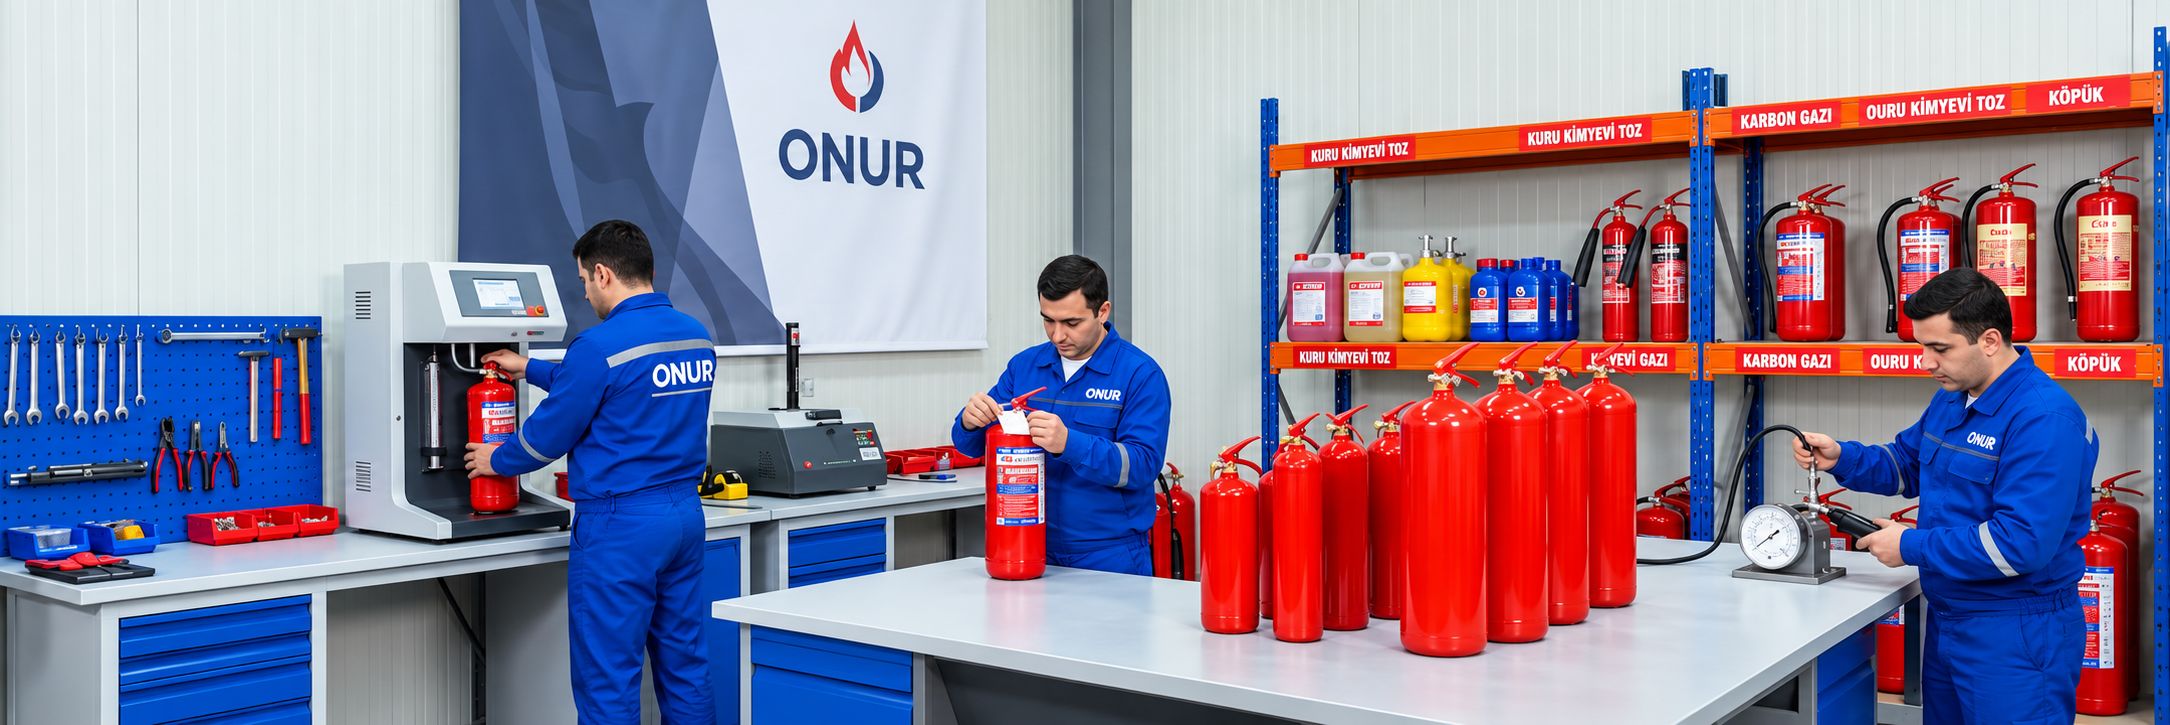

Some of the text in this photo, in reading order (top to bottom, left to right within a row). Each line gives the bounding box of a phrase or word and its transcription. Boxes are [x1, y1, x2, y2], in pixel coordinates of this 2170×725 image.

[2049, 85, 2104, 106] KÖPÜK
[1866, 92, 2005, 120] OURU KİMYEVİ TOZ
[1741, 108, 1832, 129] KARBON GAZI
[1527, 122, 1643, 146] KURU KİMYEVİ TOZ
[778, 128, 925, 190] ONUR
[1311, 141, 1409, 162] KURU KİMYEVİ TOZ
[1299, 348, 1391, 364] KURU KİMYEVİ TOZ
[1591, 350, 1668, 367] KYEVİ GAZI
[1743, 354, 1831, 368] KARBON GAZI
[1871, 354, 1909, 369] OURU
[2067, 353, 2121, 372] KÖPÜK
[652, 359, 713, 388] ONUR
[1085, 387, 1121, 401] ONUR
[1967, 431, 1996, 450] ONUR
